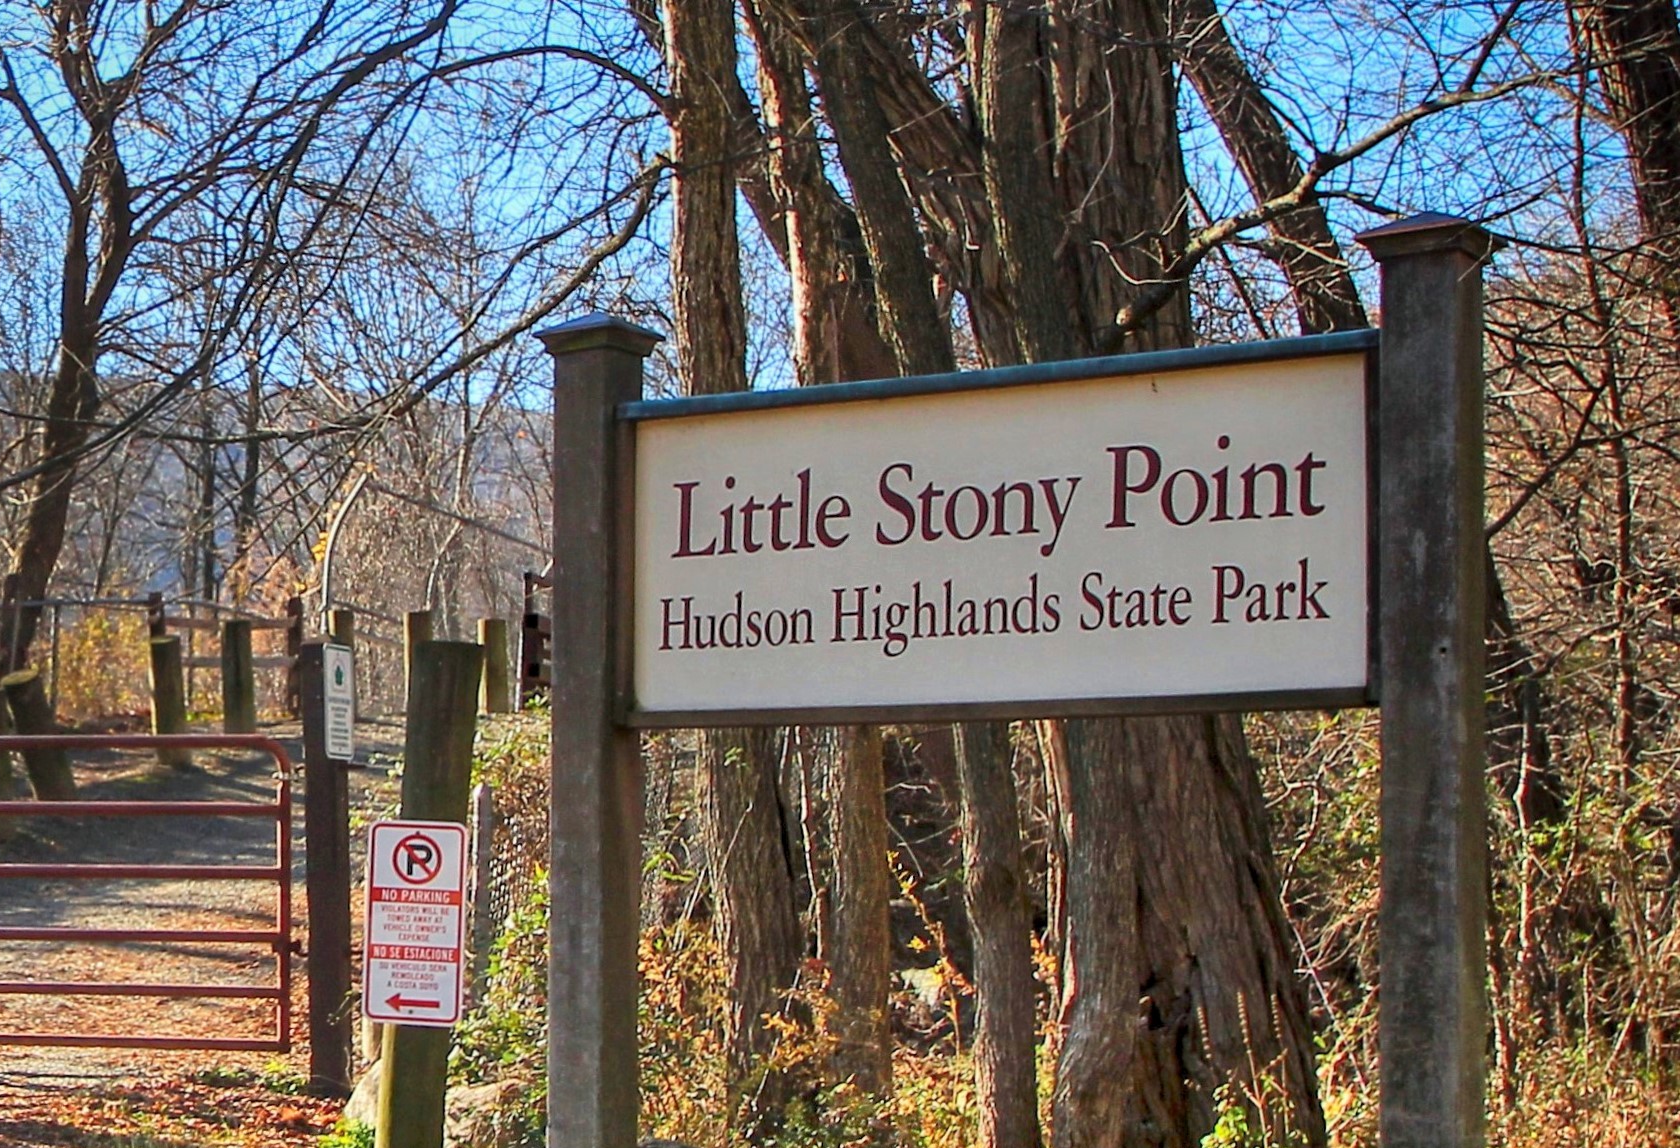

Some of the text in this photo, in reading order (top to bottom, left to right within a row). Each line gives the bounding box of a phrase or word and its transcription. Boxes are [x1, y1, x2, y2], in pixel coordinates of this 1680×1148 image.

[670, 434, 1328, 559] Little Stony Point
[657, 556, 1332, 658] Hudson Highlands State Park
[381, 888, 450, 903] NO PARKING
[381, 905, 449, 915] VIOLATORS WILL BE
[387, 914, 411, 922] TOWED
[413, 915, 432, 923] AWAY
[383, 924, 447, 934] VEHICLE OWNER'S
[398, 933, 430, 941] EXPENSE
[373, 946, 454, 961] NO SE ESTACIONE
[391, 962, 427, 971] VEHICULO
[391, 971, 434, 981] REMOLCADO
[394, 981, 417, 989] COSTA
[419, 982, 439, 990] SUYO
